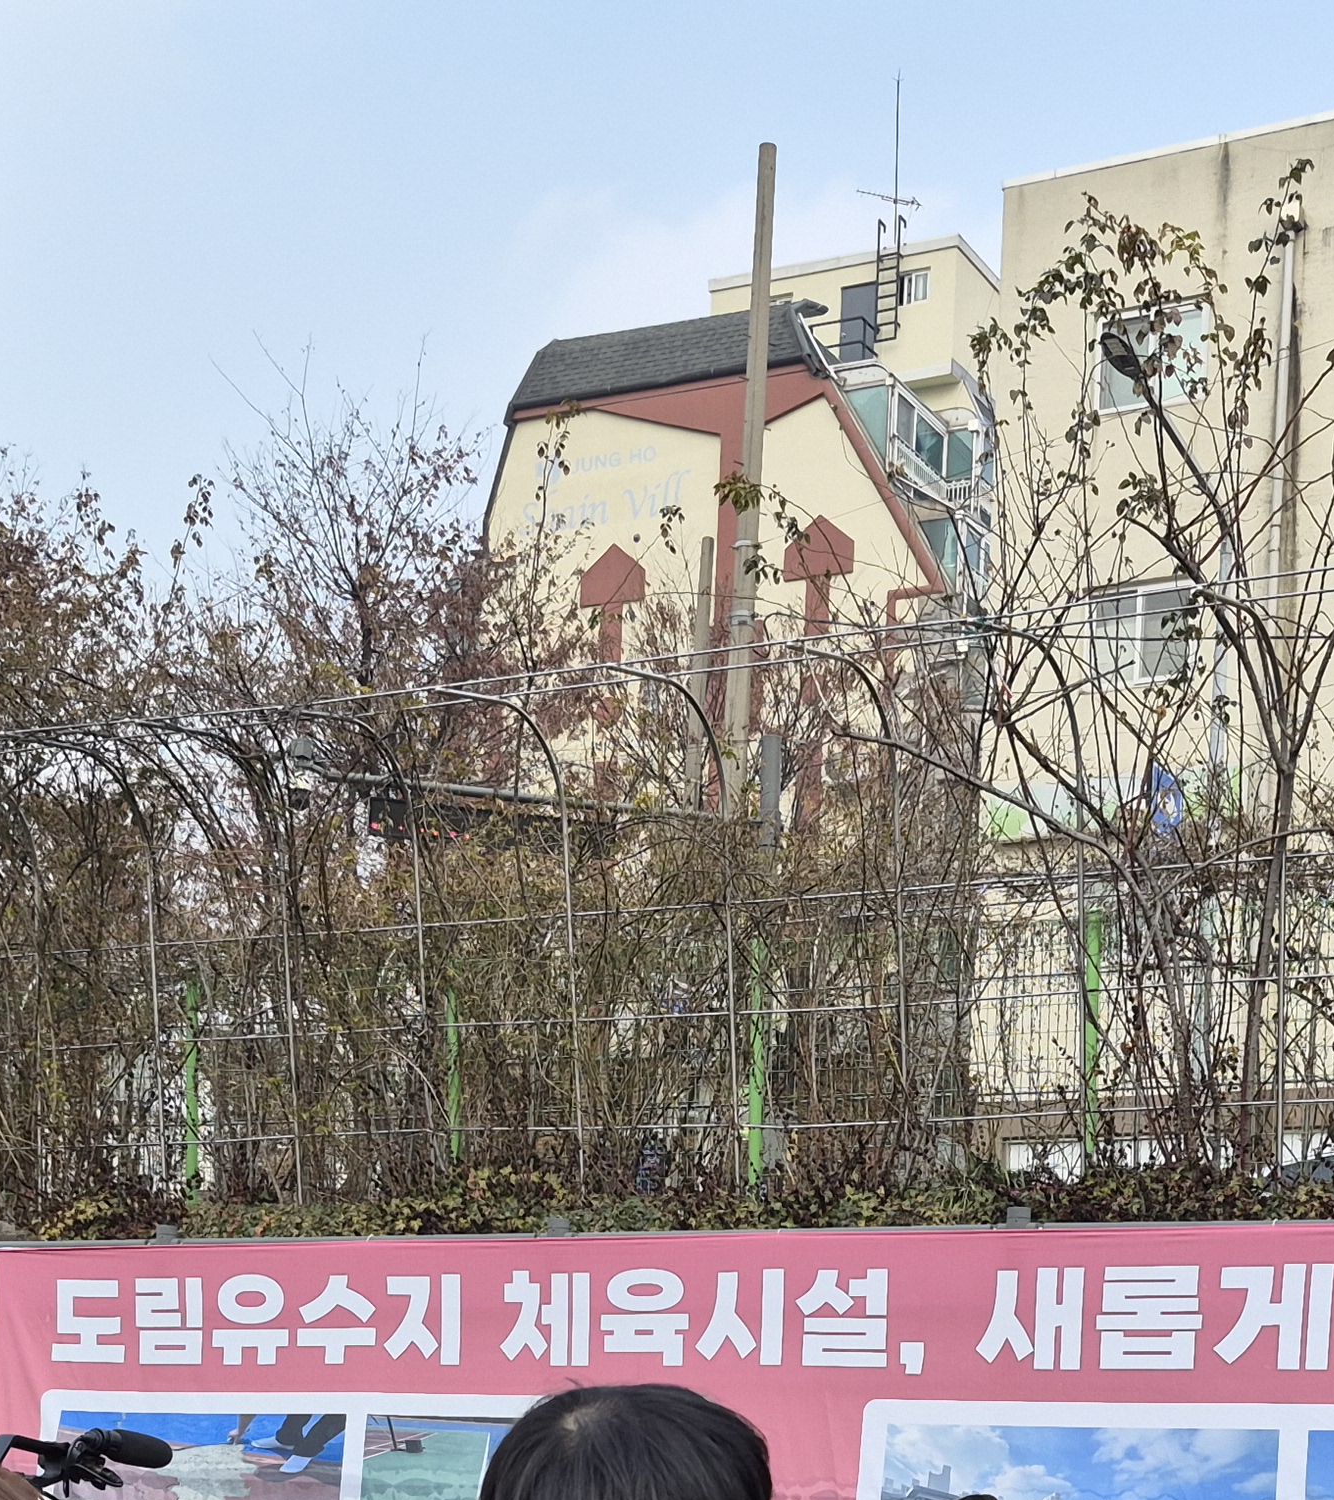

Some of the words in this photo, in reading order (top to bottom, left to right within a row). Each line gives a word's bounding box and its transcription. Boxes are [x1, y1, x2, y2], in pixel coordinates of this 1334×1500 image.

[572, 452, 622, 474] JUNG
[630, 446, 657, 464] HO
[519, 489, 609, 536] Sain
[50, 1273, 462, 1366] 도림유수지
[501, 1267, 925, 1375] 체육시설,
[975, 1263, 1334, 1372] 새롭게
